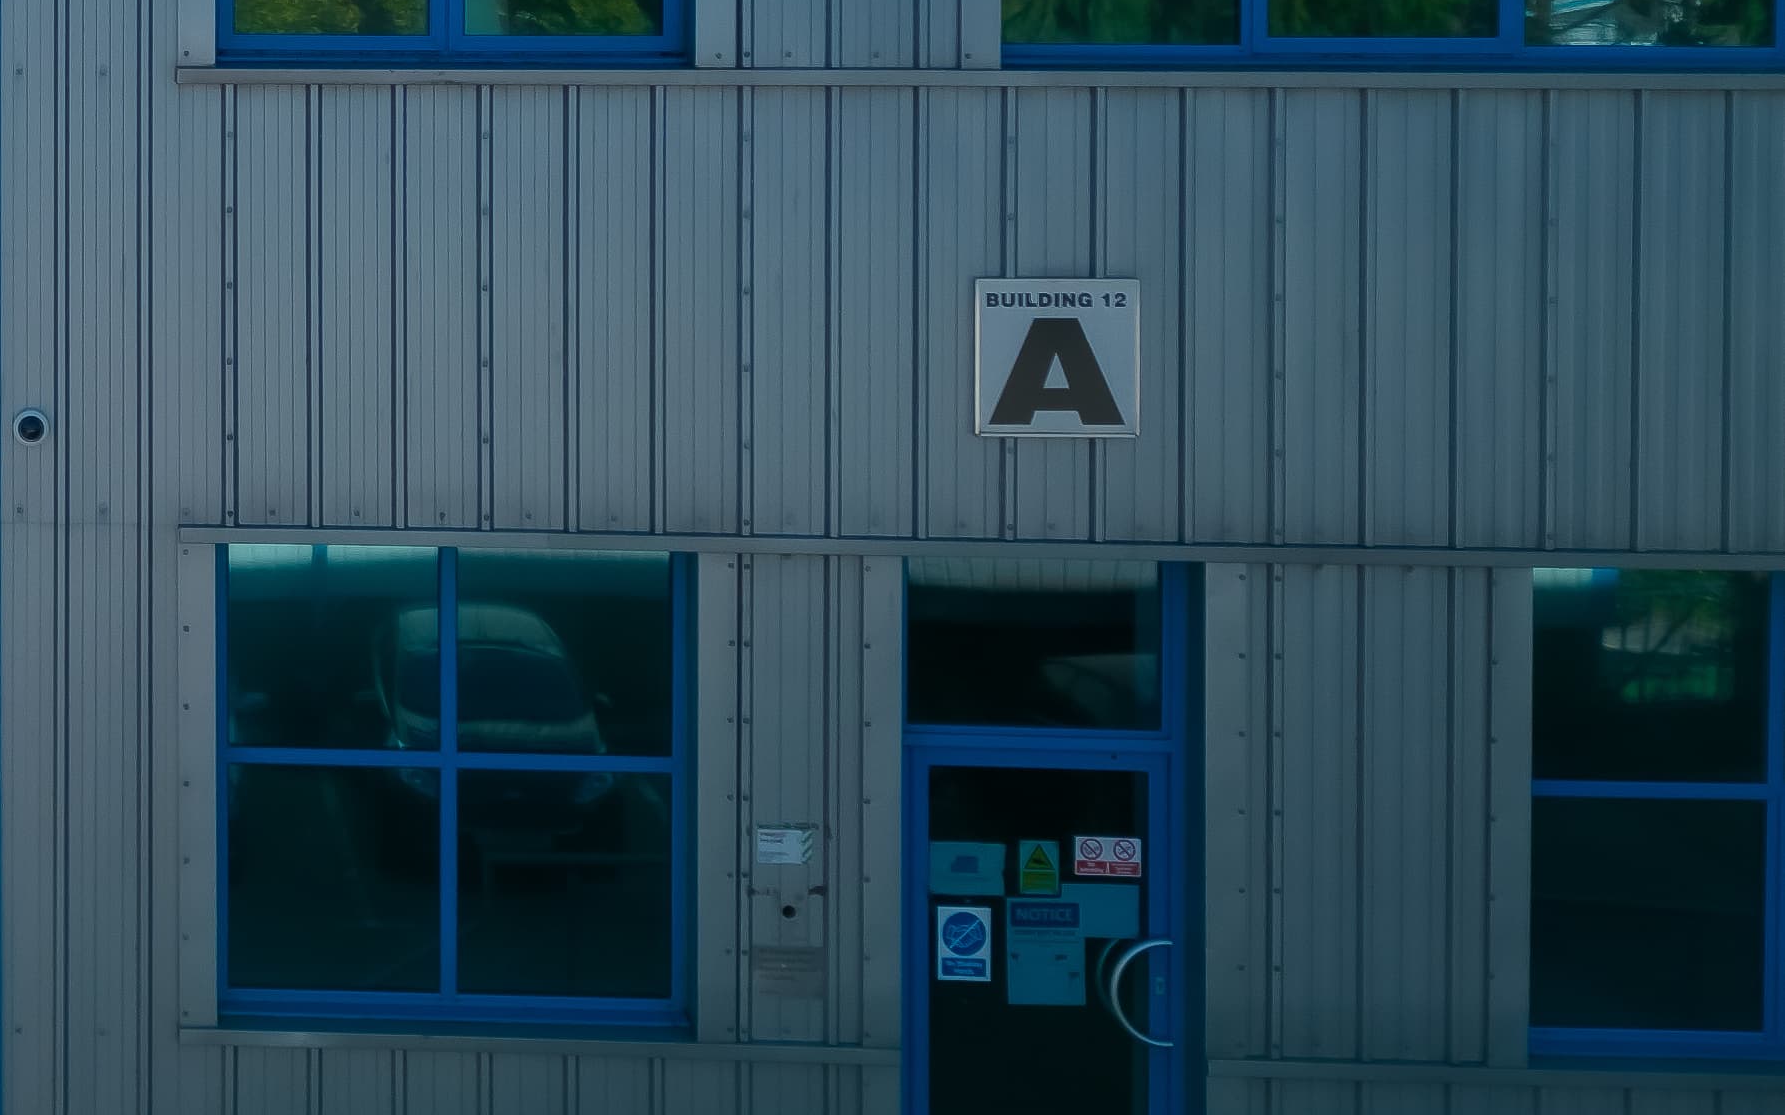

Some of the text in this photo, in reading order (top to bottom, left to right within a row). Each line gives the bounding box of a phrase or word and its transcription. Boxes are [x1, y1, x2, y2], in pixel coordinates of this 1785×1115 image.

[986, 292, 1127, 308] BUILDING 12
[988, 317, 1126, 425] A
[1016, 907, 1072, 922] NOTICE
